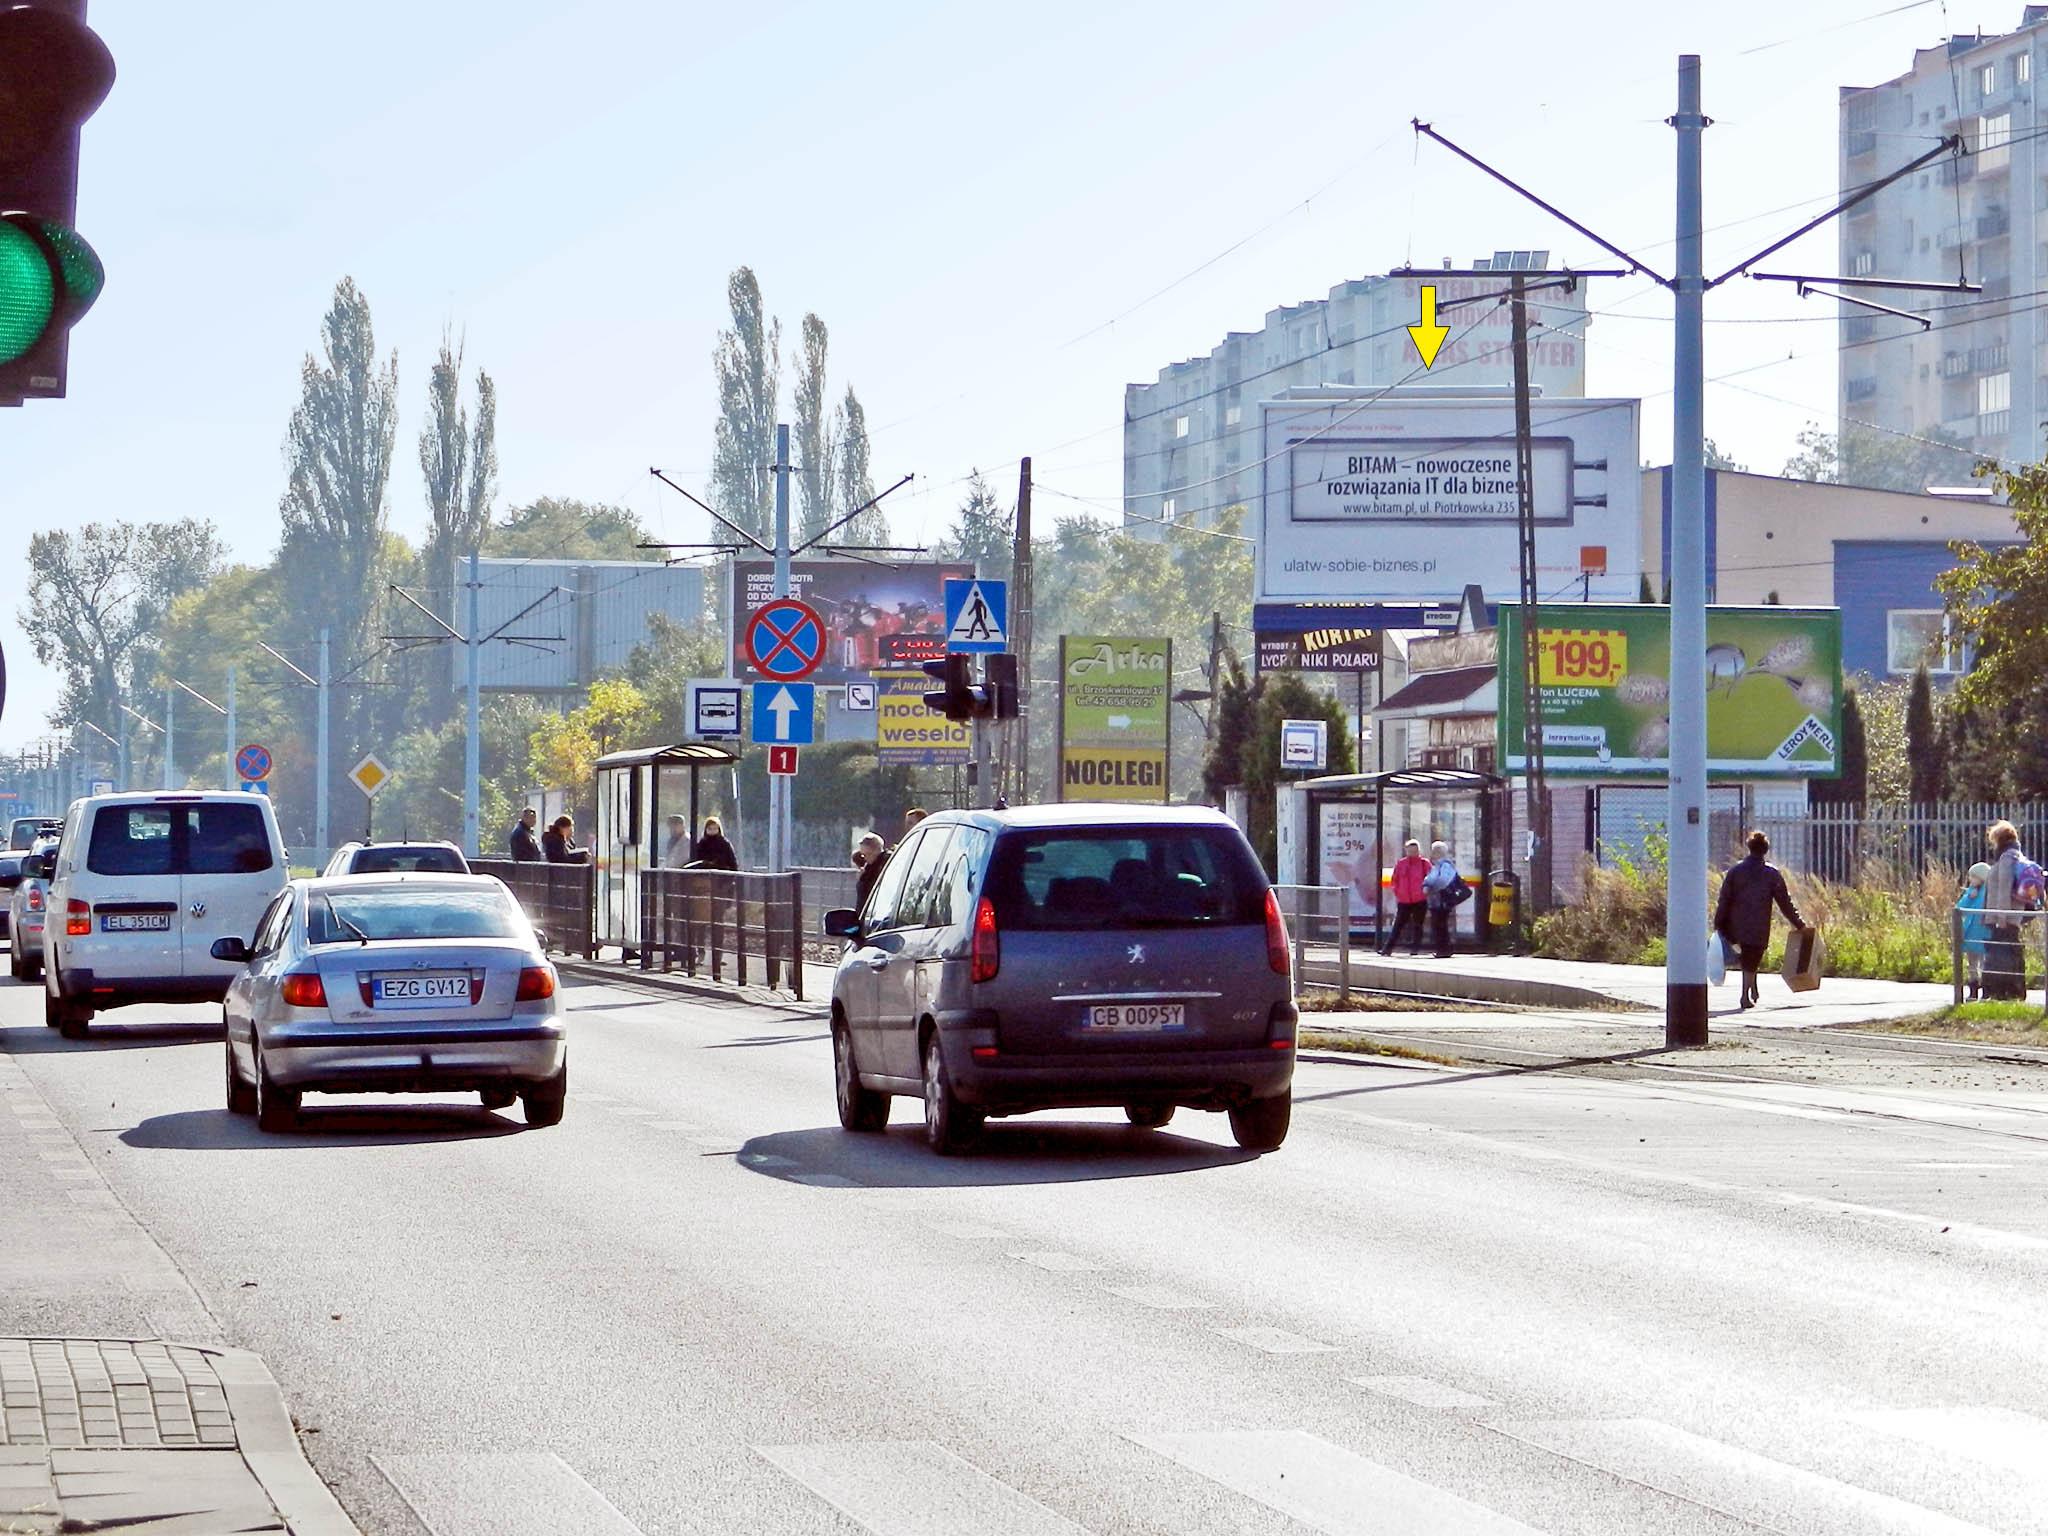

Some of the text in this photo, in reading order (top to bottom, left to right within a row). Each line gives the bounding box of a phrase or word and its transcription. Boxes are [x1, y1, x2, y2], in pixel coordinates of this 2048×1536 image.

[1348, 456, 1397, 475] BITAM
[1416, 459, 1512, 474] nowoczesne
[1327, 476, 1421, 500] rozwiązania
[1425, 477, 1439, 495] IT
[1444, 476, 1468, 495] dla
[1420, 501, 1432, 514] ul.
[1434, 501, 1494, 514] Piotrkowska
[1497, 502, 1515, 514] 235
[1068, 642, 1164, 676] Arka
[1301, 653, 1328, 667] NIKI
[1332, 653, 1378, 667] POLARU
[1557, 688, 1600, 697] LUCENA
[1778, 726, 1808, 759] LEROY
[780, 751, 787, 769] 1
[1065, 760, 1162, 787] NOCLEGI
[109, 917, 167, 928] EL 351CM
[384, 980, 420, 997] EZG
[1093, 1006, 1181, 1025] CB 0095Y
